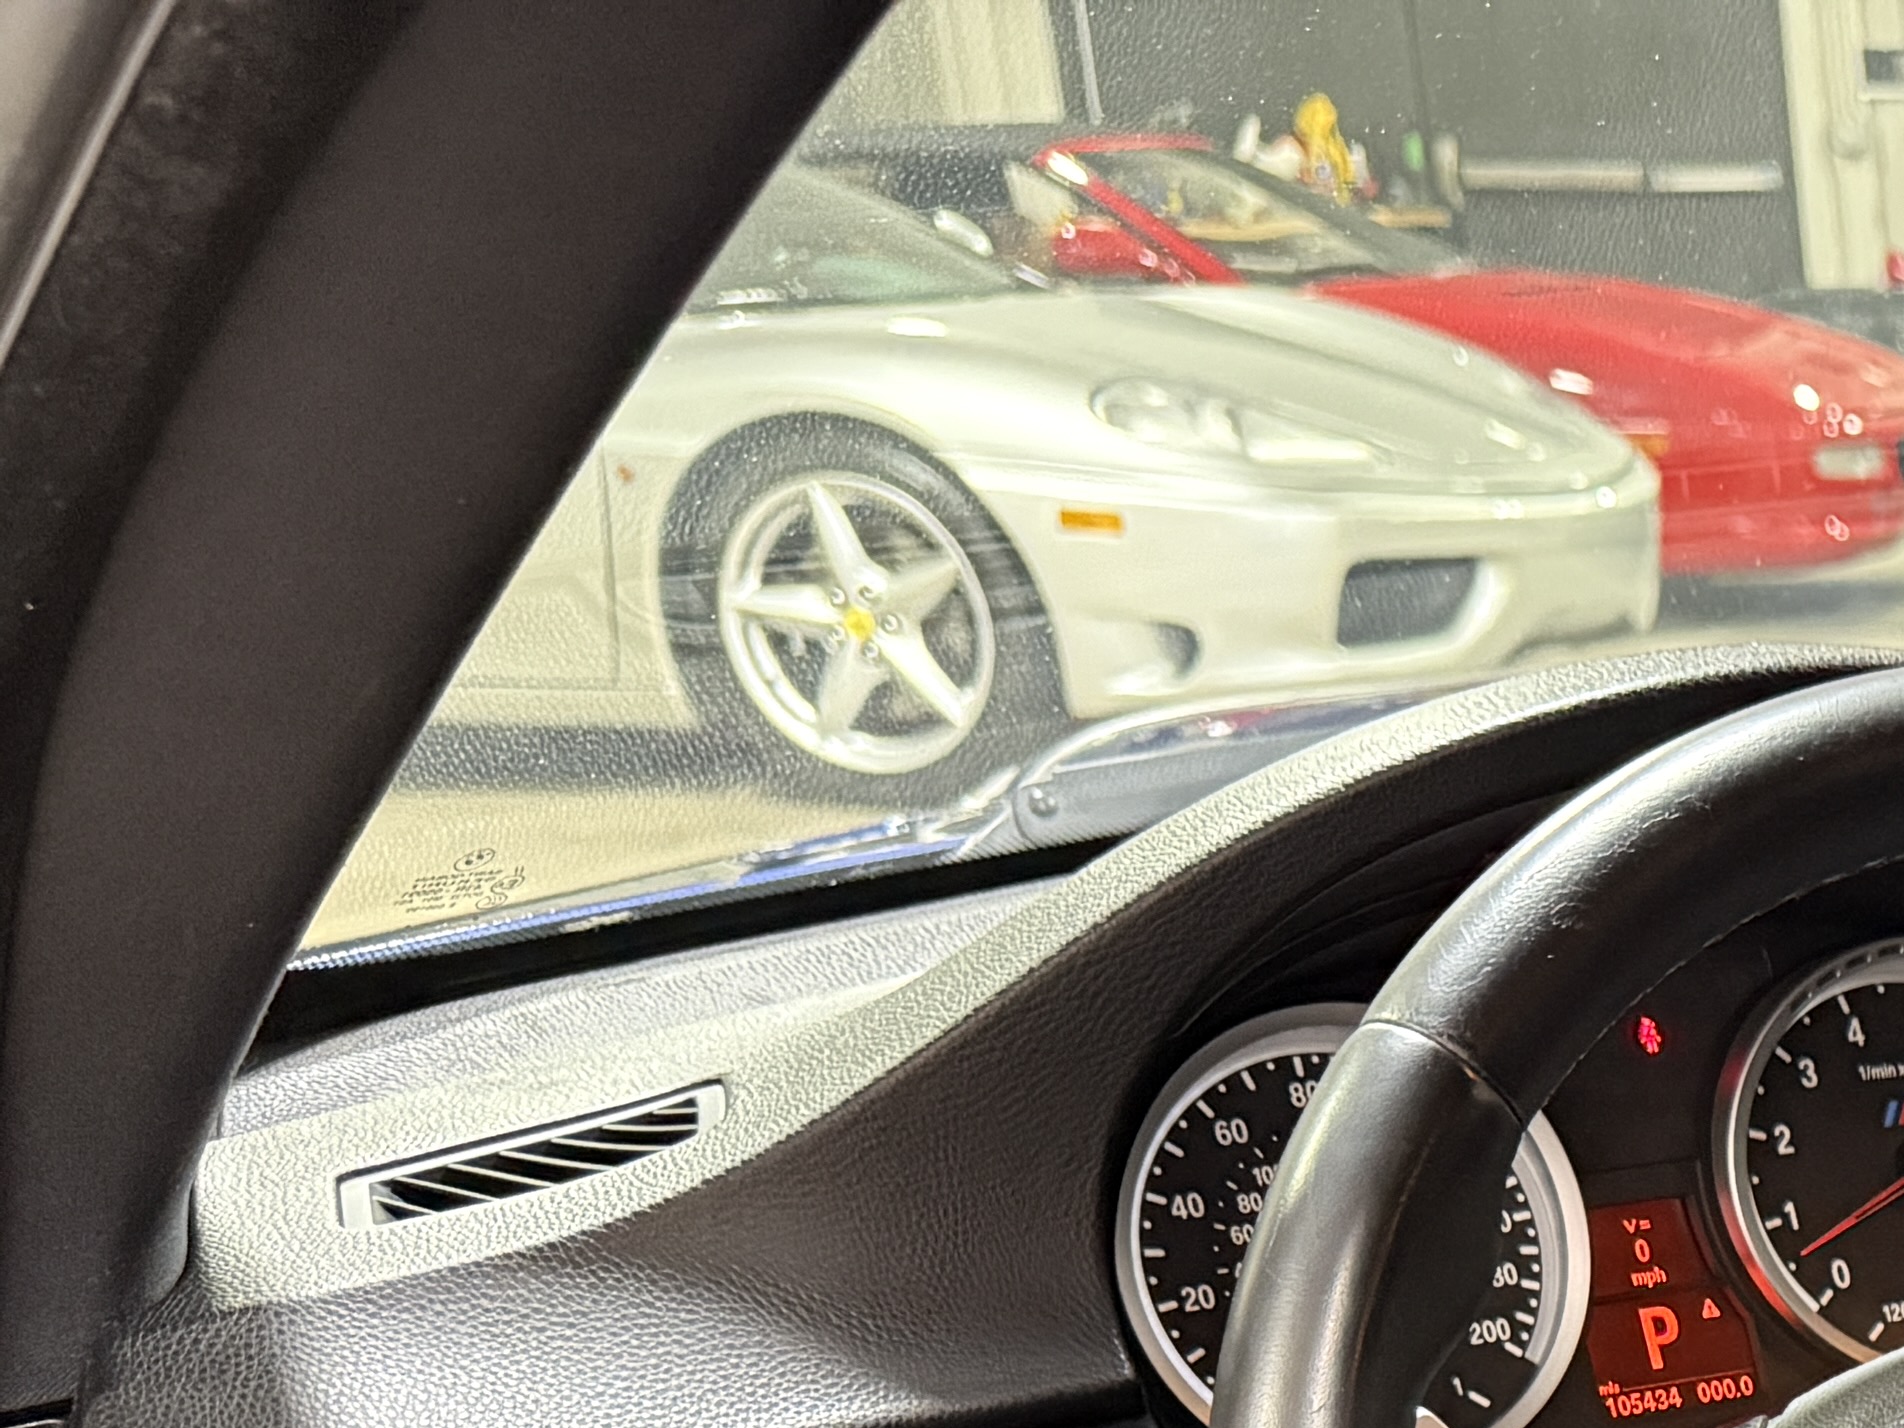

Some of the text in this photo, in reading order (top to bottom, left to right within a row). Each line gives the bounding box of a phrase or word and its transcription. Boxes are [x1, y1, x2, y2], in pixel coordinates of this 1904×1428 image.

[1847, 1016, 1866, 1047] 4
[1799, 1057, 1819, 1089] 3
[1858, 1060, 1897, 1082] 1/min
[1215, 1118, 1249, 1146] 60
[1774, 1124, 1796, 1156] 2
[1252, 1164, 1279, 1187] 10
[1171, 1191, 1206, 1220] 40
[1237, 1192, 1263, 1214] 80
[1783, 1201, 1800, 1231] 1
[1230, 1223, 1254, 1246] 60
[1634, 1238, 1650, 1263] 0
[1492, 1262, 1518, 1288] 80
[1631, 1265, 1668, 1288] mph
[1831, 1258, 1851, 1288] 0
[1180, 1283, 1215, 1313] 20
[1468, 1322, 1512, 1347] 200
[1638, 1305, 1679, 1370] P
[1605, 1374, 1754, 1419] 105434 000.0
